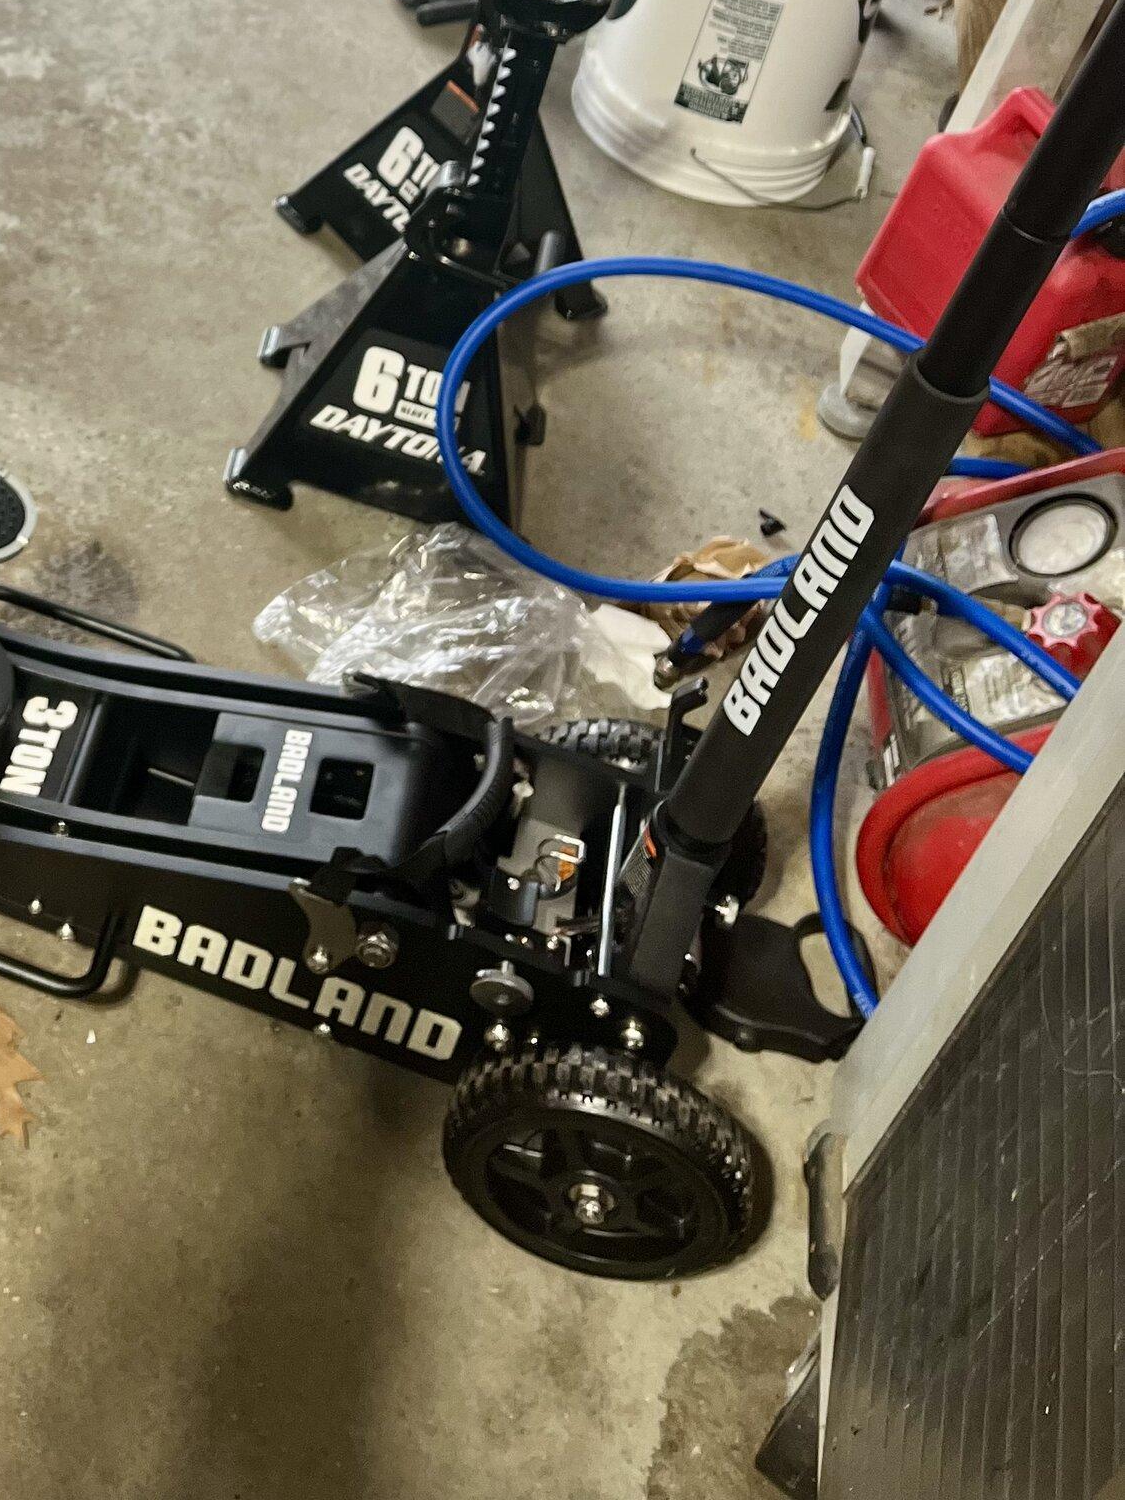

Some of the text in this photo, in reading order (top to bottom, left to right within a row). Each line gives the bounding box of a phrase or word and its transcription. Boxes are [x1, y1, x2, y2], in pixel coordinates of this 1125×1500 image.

[344, 162, 411, 233] DAYT
[377, 126, 424, 187] 6
[353, 345, 405, 414] 6
[724, 484, 875, 736] BADLAND
[261, 729, 313, 833] BADLAND
[132, 904, 463, 1062] BADLAND
